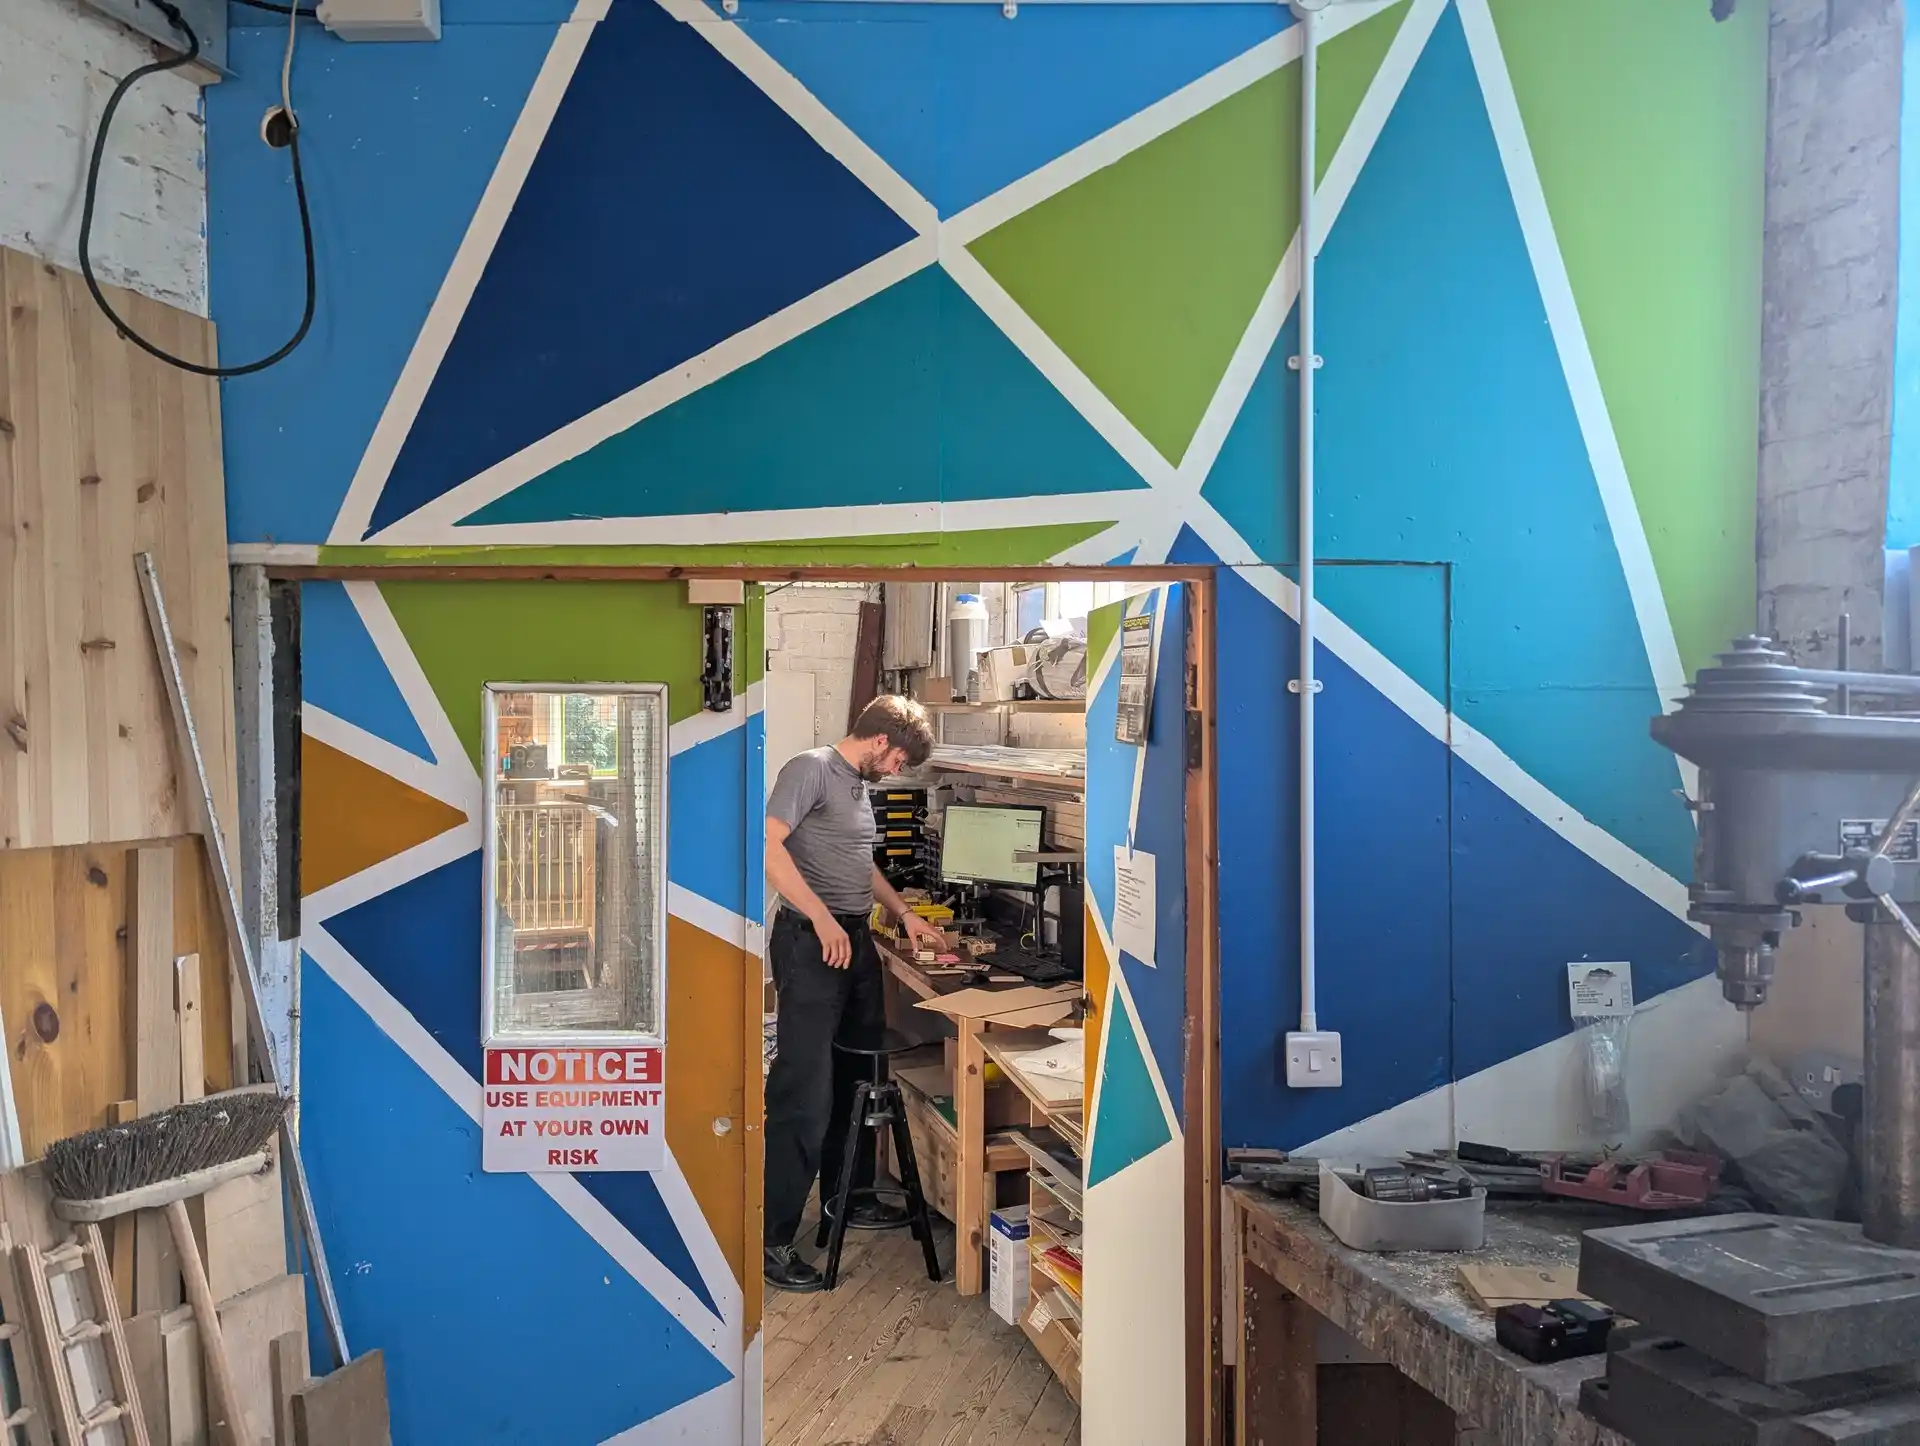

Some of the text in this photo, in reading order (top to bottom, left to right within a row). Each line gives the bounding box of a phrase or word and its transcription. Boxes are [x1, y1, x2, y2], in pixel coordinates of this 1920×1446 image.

[501, 1052, 648, 1081] NOTICE
[486, 1090, 662, 1107] USE EQUIPMENT
[499, 1119, 649, 1137] AT YOUR OWN
[548, 1149, 599, 1165] RISK
